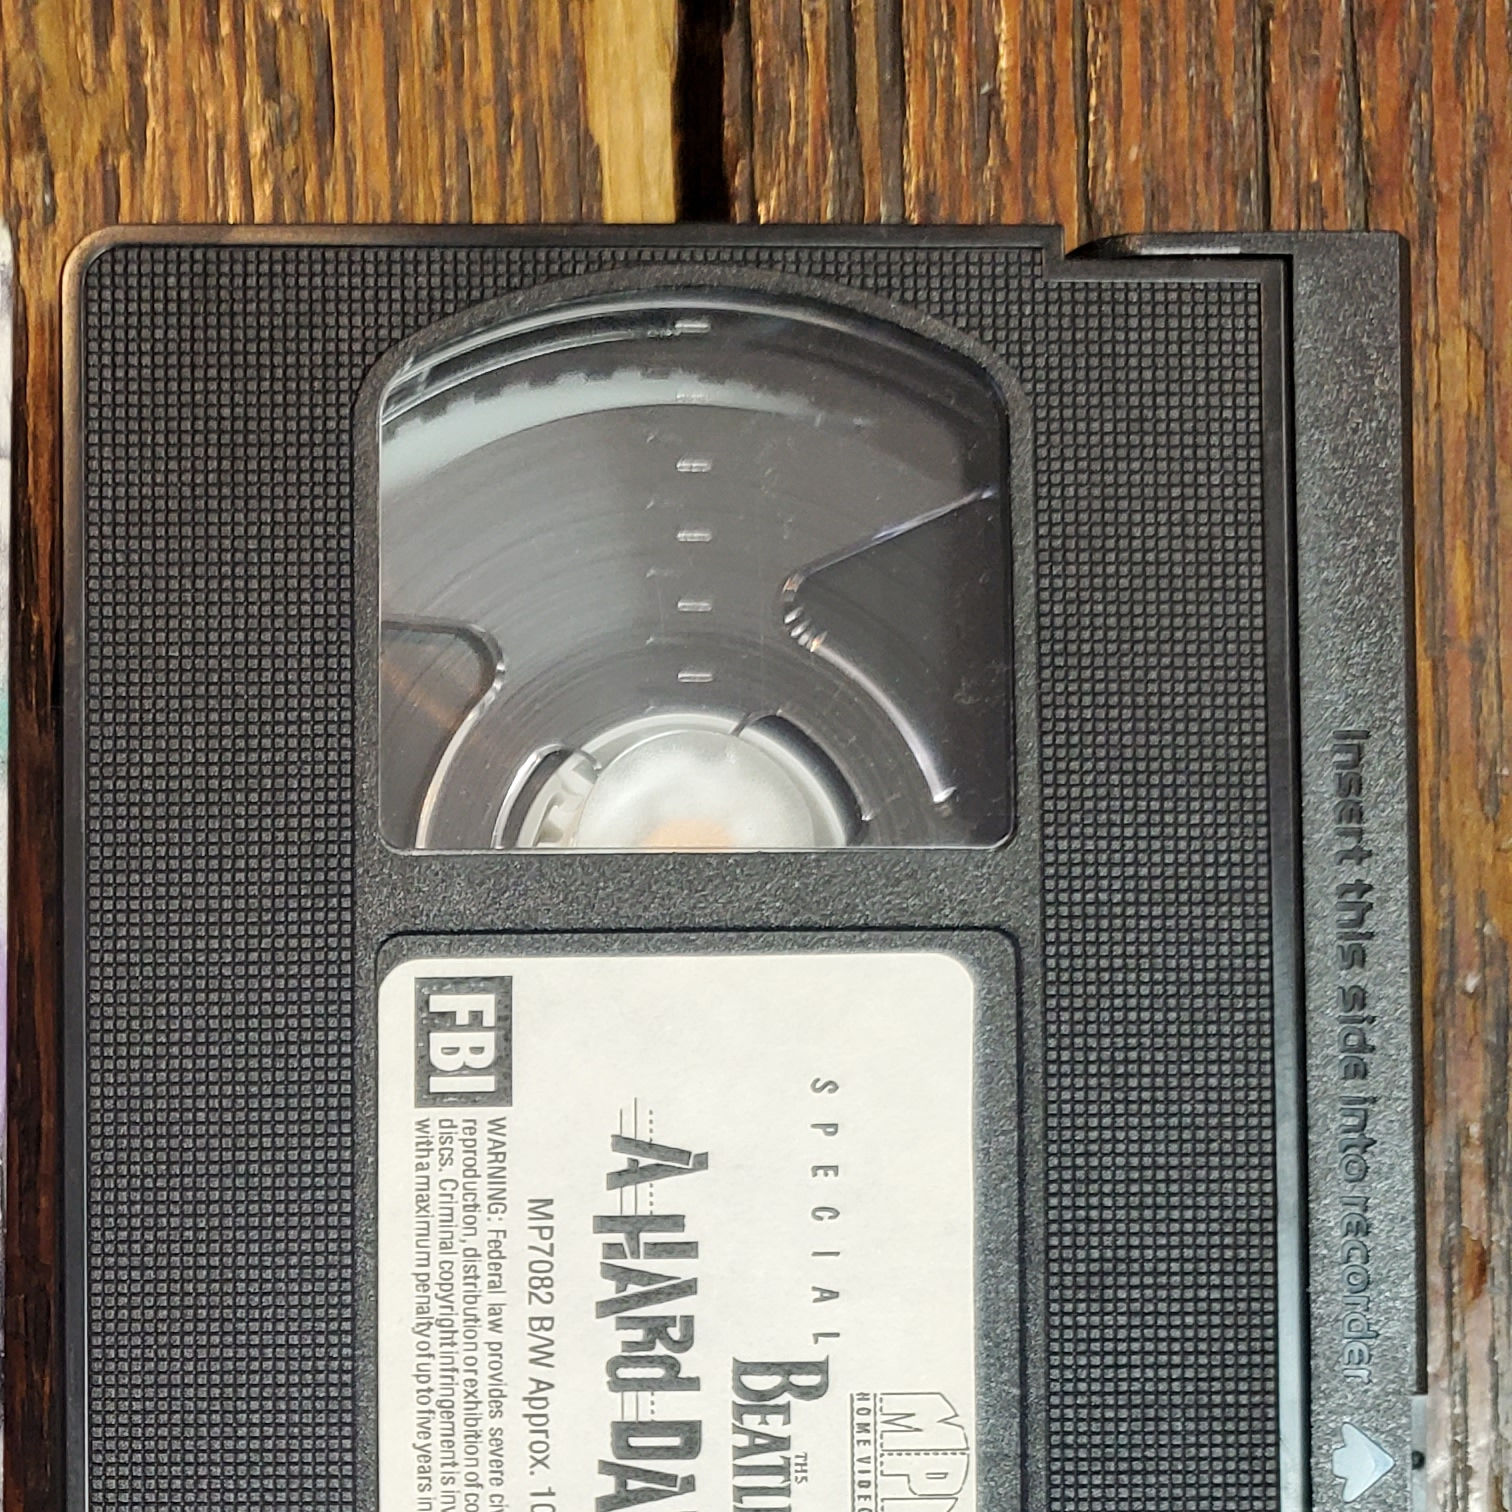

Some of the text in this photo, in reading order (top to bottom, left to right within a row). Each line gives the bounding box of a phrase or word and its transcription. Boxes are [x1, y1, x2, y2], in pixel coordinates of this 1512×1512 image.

[428, 993, 496, 1093] FBI
[1332, 729, 1380, 1382] Insert this side into recorder
[415, 1118, 435, 1160] with
[415, 1162, 430, 1171] a
[438, 1118, 458, 1172] discs.
[606, 1135, 708, 1191] A
[459, 1118, 481, 1244] reproduction,
[487, 1117, 507, 1222] WARNING:
[415, 1175, 435, 1268] maximum
[439, 1178, 459, 1254] Criminal
[810, 1078, 840, 1344] SPECIAL
[487, 1229, 507, 1294] Federal
[527, 1198, 554, 1305] MP7082
[412, 1272, 435, 1337] penalty
[435, 1260, 459, 1348] copyright
[462, 1247, 483, 1351] distribution
[487, 1303, 507, 1334] law
[416, 1341, 435, 1358] of
[462, 1356, 479, 1374] or
[528, 1317, 554, 1368] B/W
[412, 1363, 431, 1384] up
[416, 1387, 434, 1405] to
[483, 1342, 508, 1419] provides
[416, 1409, 436, 1440] five
[435, 1351, 459, 1468] infringement
[462, 1378, 483, 1467] exhibition
[522, 1377, 555, 1476] Approx.
[856, 1392, 871, 1447] HOME
[412, 1444, 433, 1492] years
[440, 1471, 460, 1486] is
[464, 1472, 484, 1490] of
[488, 1427, 505, 1487] severe
[417, 1497, 436, 1511] in
